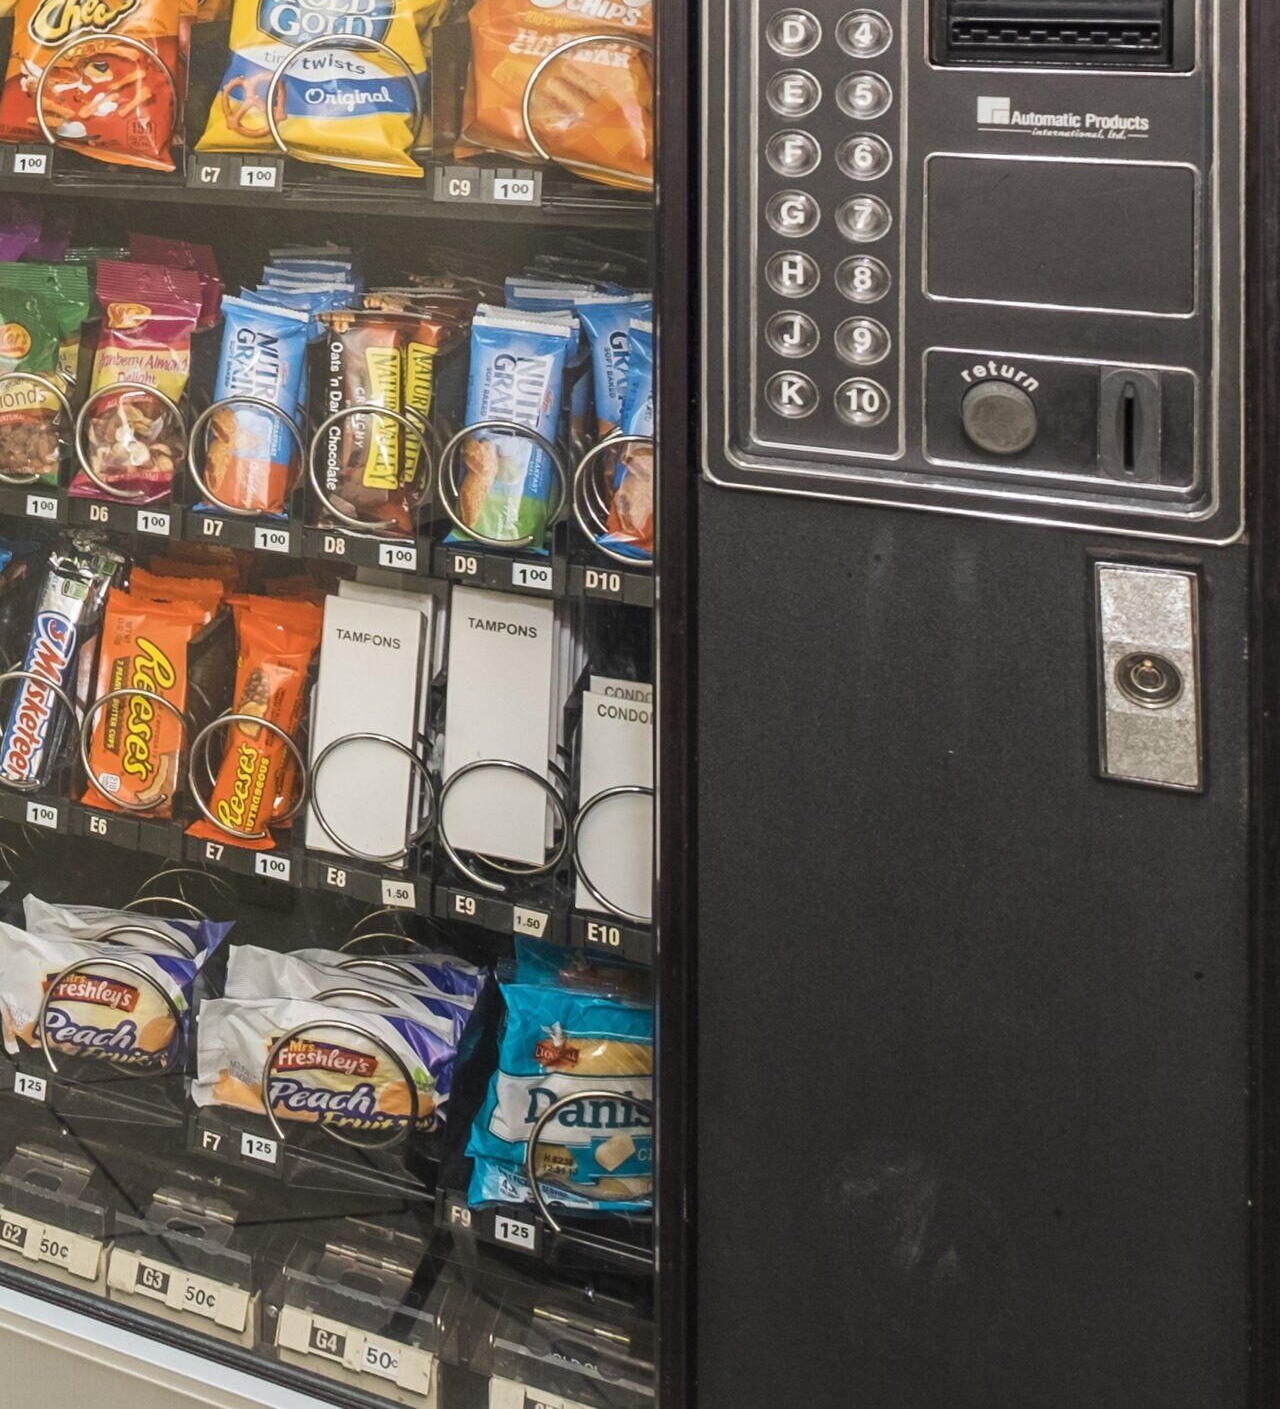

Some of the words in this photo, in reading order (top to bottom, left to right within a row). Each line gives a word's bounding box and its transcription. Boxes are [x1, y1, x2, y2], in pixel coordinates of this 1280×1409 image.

[268, 3, 375, 41] GOLD
[783, 22, 806, 44] D
[853, 23, 873, 45] 4
[302, 53, 367, 75] twists
[304, 86, 394, 112] Original
[784, 82, 805, 105] E
[854, 84, 873, 106] 5
[1010, 110, 1082, 128] Automatic
[1084, 112, 1150, 131] Products
[784, 142, 804, 165] F
[853, 144, 873, 167] 6
[199, 165, 221, 184] C7
[448, 178, 471, 197] C9
[780, 201, 806, 225] G
[853, 205, 873, 228] 7
[781, 262, 805, 285] H
[852, 267, 872, 290] 8
[786, 319, 803, 345] J
[852, 329, 872, 352] 9
[330, 341, 344, 373] Oats
[959, 359, 1040, 393] return
[329, 389, 343, 415] Dar
[780, 383, 804, 405] K
[846, 388, 879, 414] 10
[326, 425, 341, 491] Chocolate
[89, 504, 109, 523] D6
[202, 518, 224, 536] D7
[323, 536, 346, 555] D8
[453, 555, 478, 575] D9
[585, 570, 621, 593] D10
[335, 628, 402, 650] TAMPONS
[467, 616, 539, 639] TAMPONS
[123, 636, 177, 783] Reese's
[595, 703, 653, 725] CONDO
[217, 741, 258, 830] Reese's
[89, 815, 108, 836] E6
[205, 841, 224, 862] E7
[326, 866, 347, 888] E8
[385, 886, 410, 902] 1.50
[454, 894, 477, 917] E9
[515, 914, 541, 931] 1.50
[586, 922, 620, 947] E10
[44, 1011, 134, 1051] Peach
[278, 1049, 371, 1076] Freshley's
[269, 1081, 373, 1115] Peach
[202, 1129, 222, 1151] F7
[450, 1205, 471, 1226] F9
[1, 1221, 23, 1245] G2
[40, 1237, 70, 1261] 50¢
[141, 1264, 164, 1290] G3
[183, 1284, 217, 1310] 50¢
[315, 1327, 339, 1352] G4
